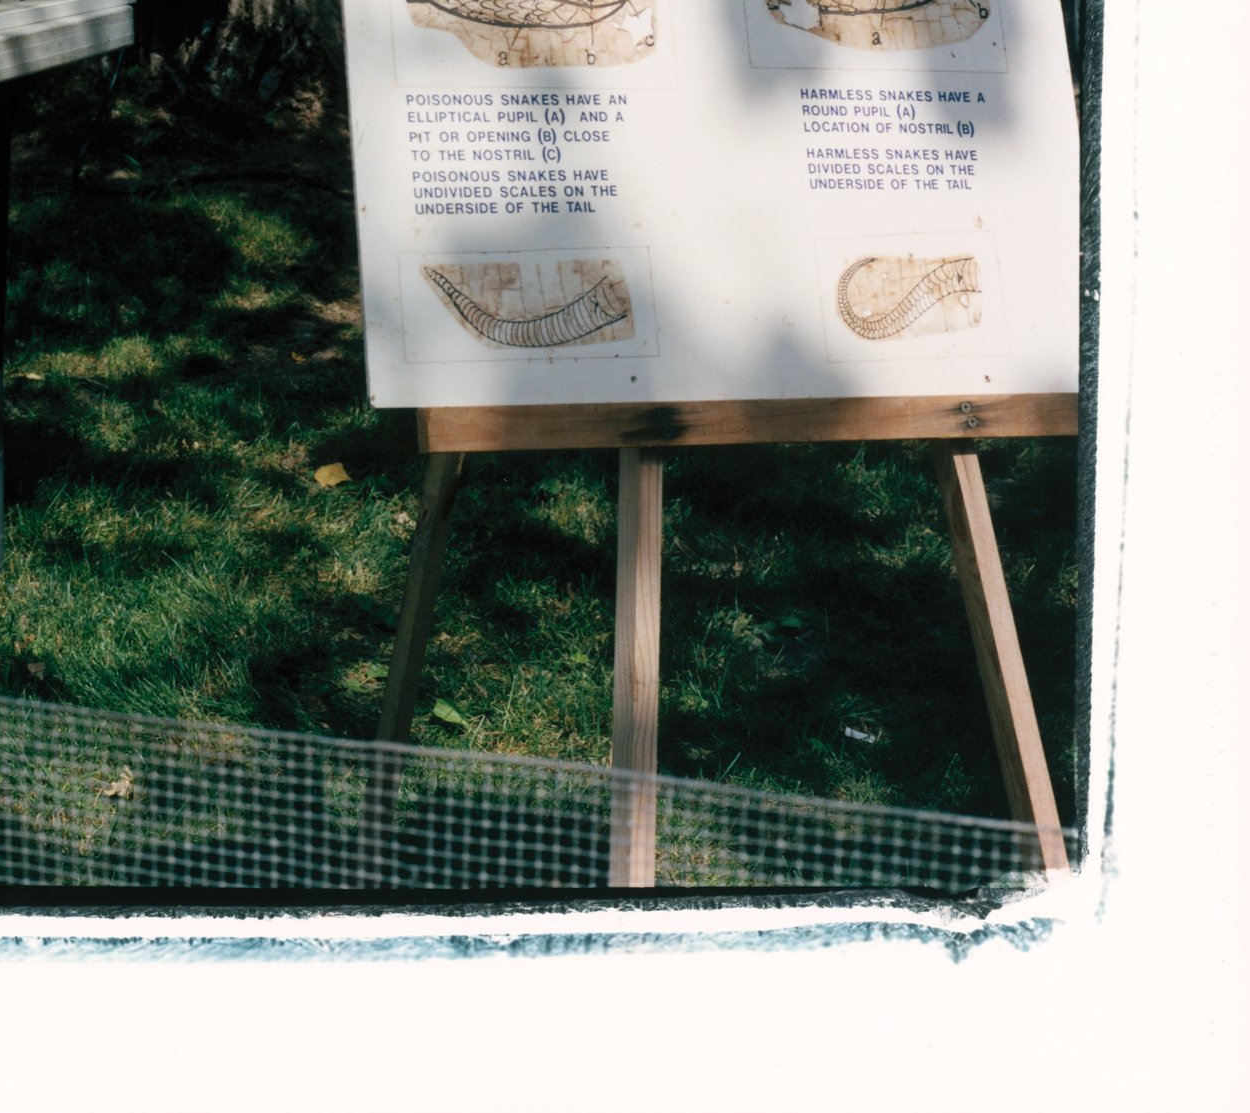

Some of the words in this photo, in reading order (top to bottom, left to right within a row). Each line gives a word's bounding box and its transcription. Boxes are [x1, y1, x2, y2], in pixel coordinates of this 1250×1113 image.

[872, 32, 882, 46] a
[499, 51, 510, 66] a
[587, 49, 596, 65] b
[406, 94, 493, 106] POISONOUS
[501, 94, 559, 106] SNAKES
[566, 94, 601, 106] HAVE
[609, 94, 627, 106] AN
[800, 89, 873, 101] HARMLESS
[879, 90, 933, 102] SNAKES
[938, 91, 971, 103] HAVE
[976, 92, 986, 103] A
[407, 111, 491, 123] ELLIPTICAL
[498, 112, 537, 123] PUPIL
[544, 108, 565, 125] (A)
[579, 111, 608, 123] AND
[615, 112, 624, 122] A
[802, 105, 847, 116] ROUND
[854, 106, 890, 117] PUPIL
[897, 104, 916, 120] (A)
[803, 121, 869, 133] LOCATION
[876, 123, 892, 133] OF
[900, 123, 953, 135] NOSTRIL
[957, 121, 975, 137] (B)
[409, 131, 431, 143] PIT
[440, 132, 459, 142] OR
[467, 131, 531, 142] OPENING
[538, 128, 557, 145] (B)
[563, 131, 610, 142] CLOSE
[411, 150, 430, 161] TO
[440, 150, 466, 161] THE
[473, 150, 535, 161] NOSTRIL
[542, 146, 561, 163] (C)
[806, 148, 879, 160] HARMLESS
[886, 149, 939, 160] SNAKES
[945, 150, 978, 161] HAVE
[412, 171, 500, 182] POISONOUS
[508, 170, 566, 181] SNAKES
[573, 170, 609, 181] HAVE
[808, 164, 861, 175] DIVIDED
[867, 164, 919, 175] SCALES
[926, 165, 943, 175] ON
[950, 165, 975, 176] THE
[810, 179, 884, 190] UNDERSIDE
[891, 179, 908, 190] OF
[914, 179, 938, 190] THE
[946, 179, 971, 190] TAIL
[414, 187, 492, 199] UNDIVIDED
[500, 186, 557, 198] SCALES
[564, 186, 584, 197] ON
[590, 186, 618, 197] THE
[415, 202, 498, 214] UNDERSIDE
[505, 202, 524, 214] OF
[532, 202, 559, 213] THE
[566, 201, 596, 213] TAIL
